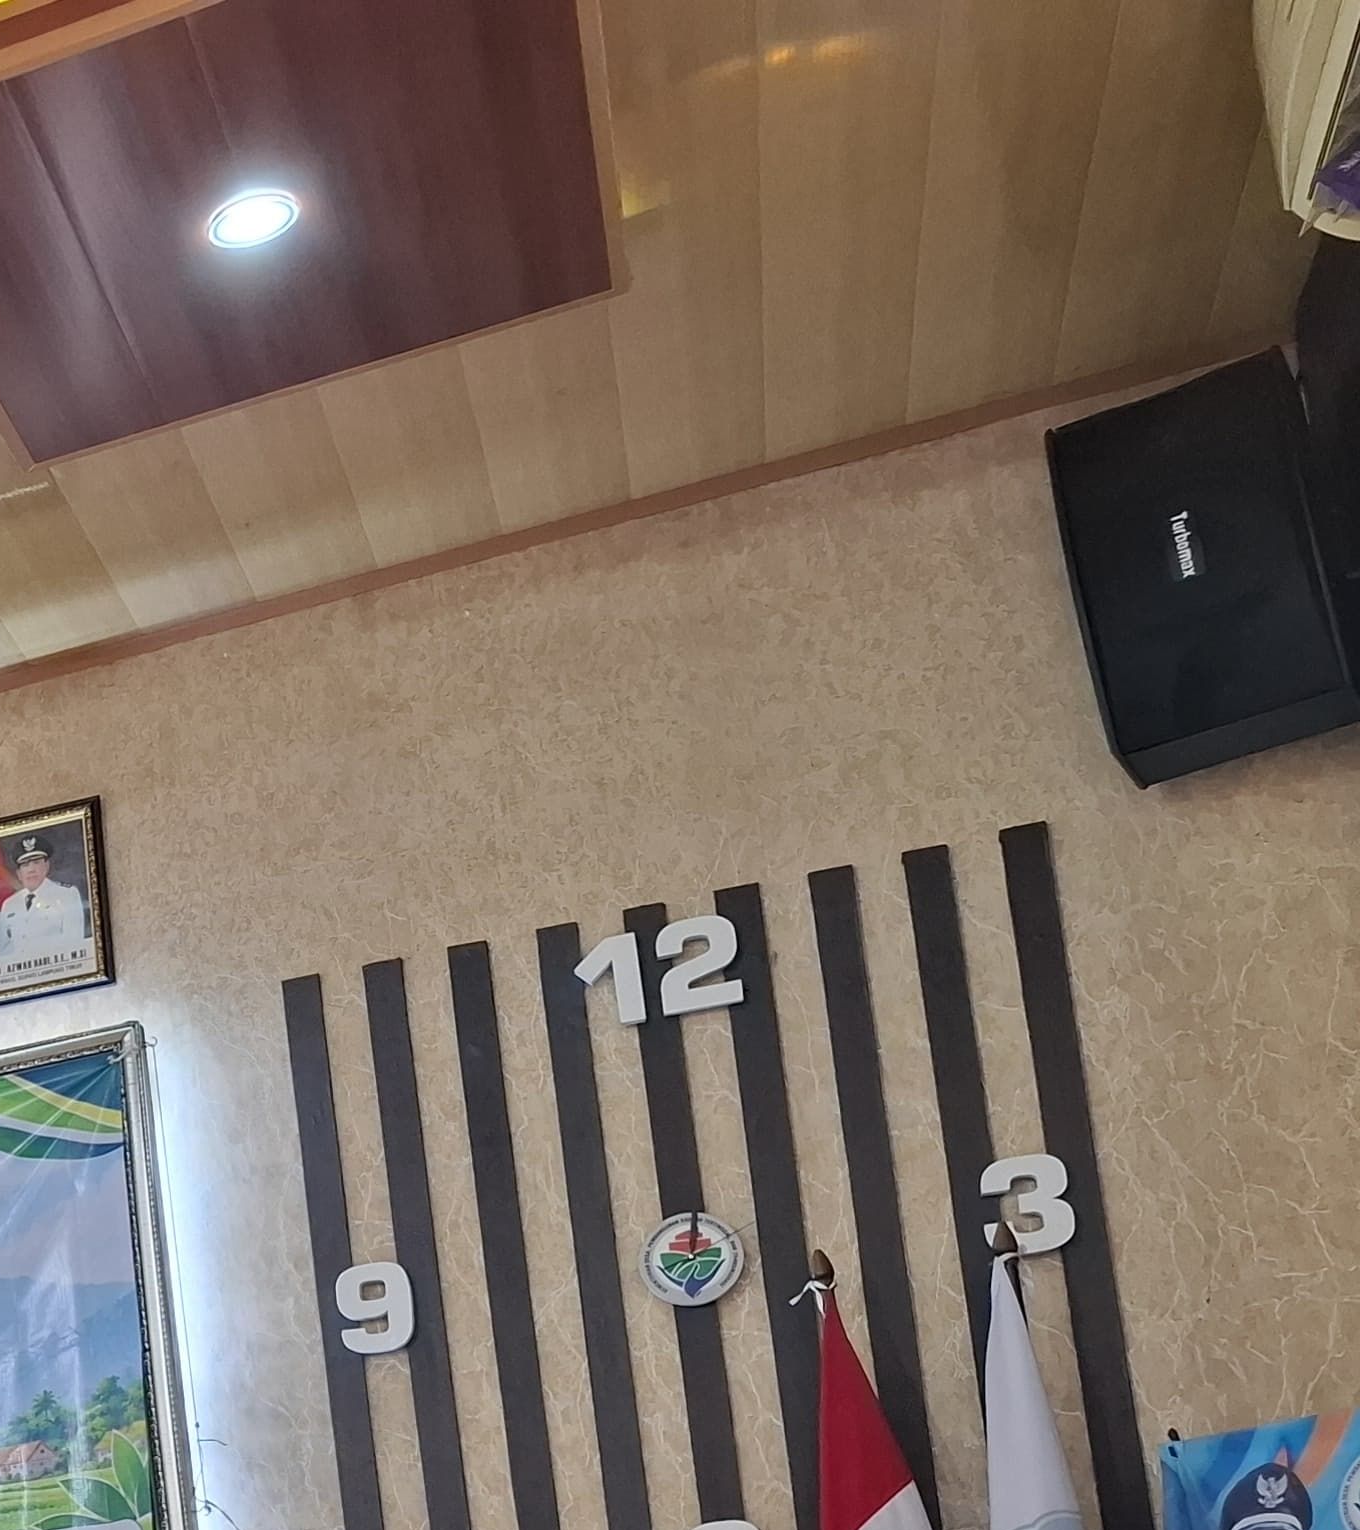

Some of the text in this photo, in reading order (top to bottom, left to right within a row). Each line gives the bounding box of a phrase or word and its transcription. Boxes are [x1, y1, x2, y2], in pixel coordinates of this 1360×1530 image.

[1169, 510, 1196, 579] Turbomax
[574, 915, 744, 1026] 12
[978, 1153, 1076, 1255] 3
[334, 1261, 415, 1355] 9
